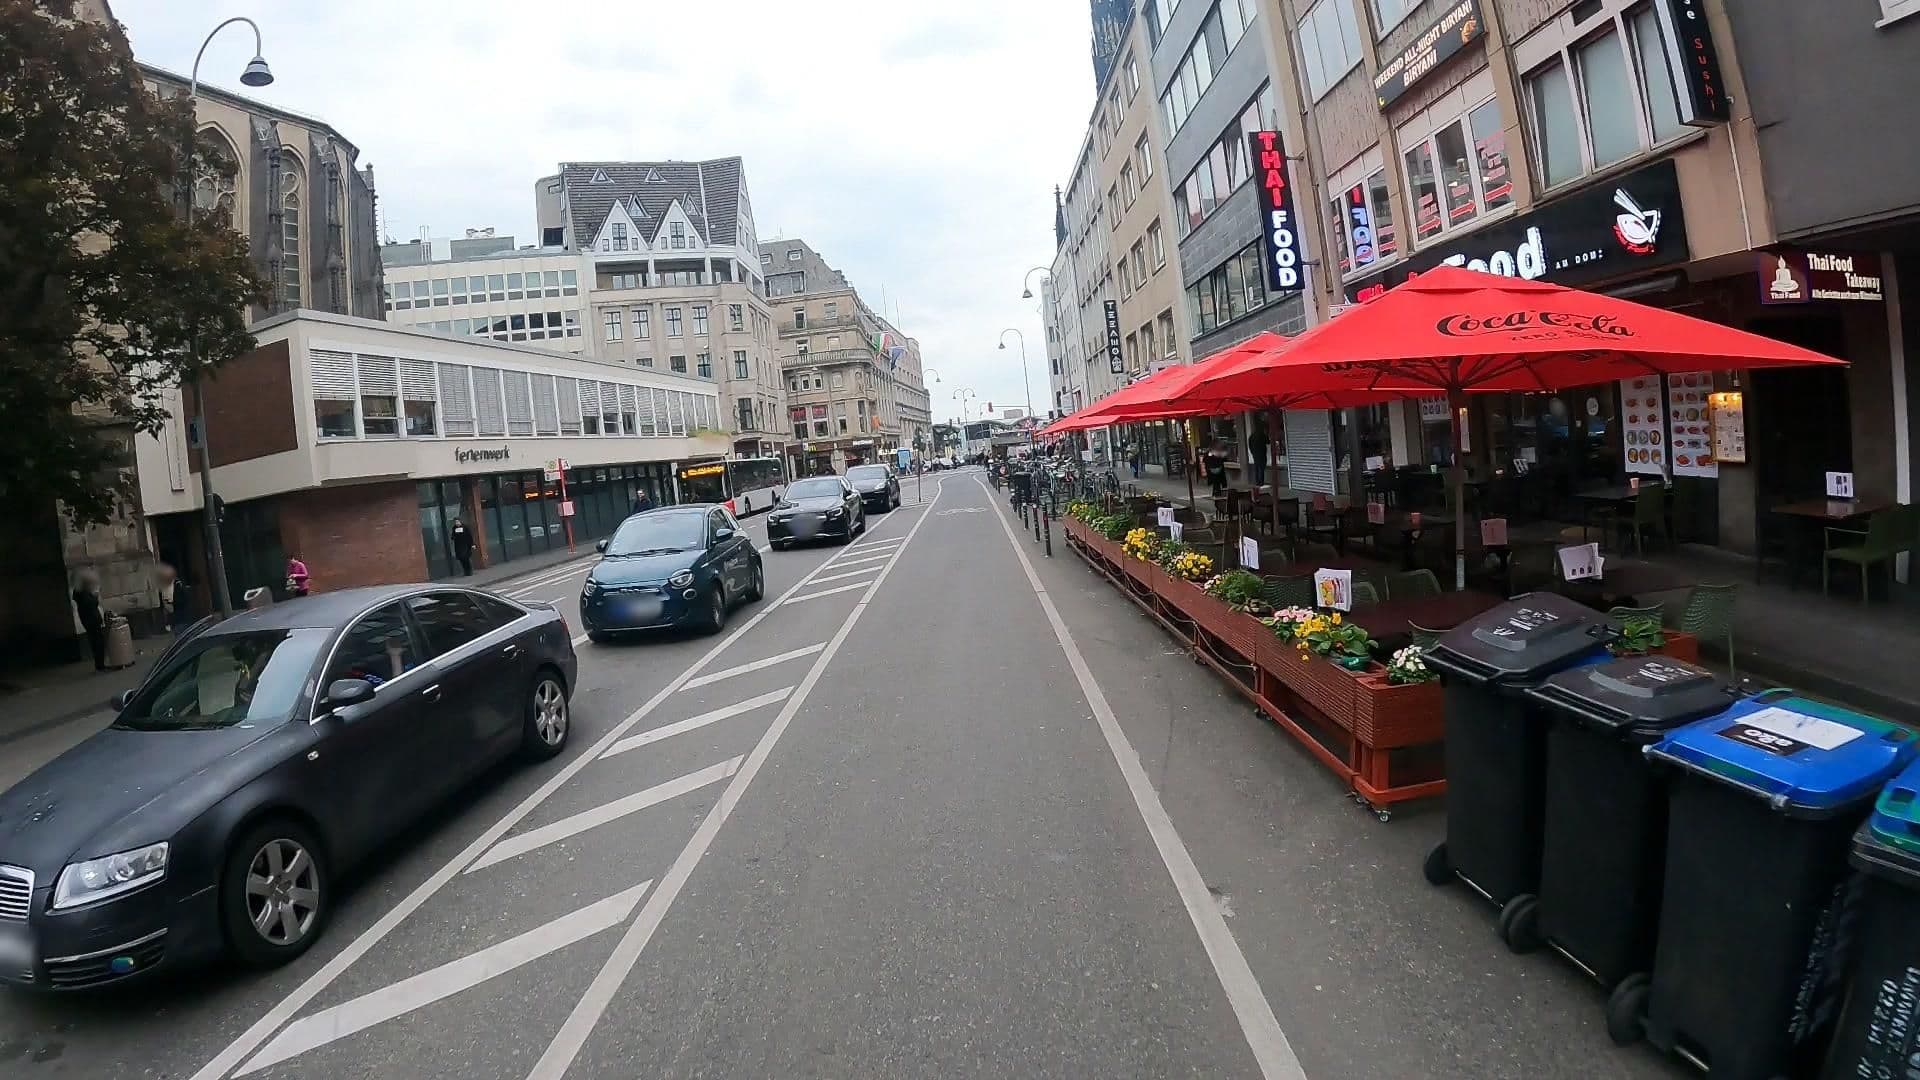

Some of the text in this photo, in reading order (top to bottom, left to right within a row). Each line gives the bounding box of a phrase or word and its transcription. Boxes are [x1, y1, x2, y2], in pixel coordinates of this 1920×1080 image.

[1374, 57, 1404, 89] WEEKEND
[1404, 25, 1440, 64] ALL-NIGHT
[1440, 0, 1473, 34] BIRYANI
[1403, 49, 1438, 87] BIRYANI
[1258, 132, 1297, 287] THAI FOOD
[1807, 253, 1853, 272] Thai Food
[1844, 272, 1880, 292] Takeaway
